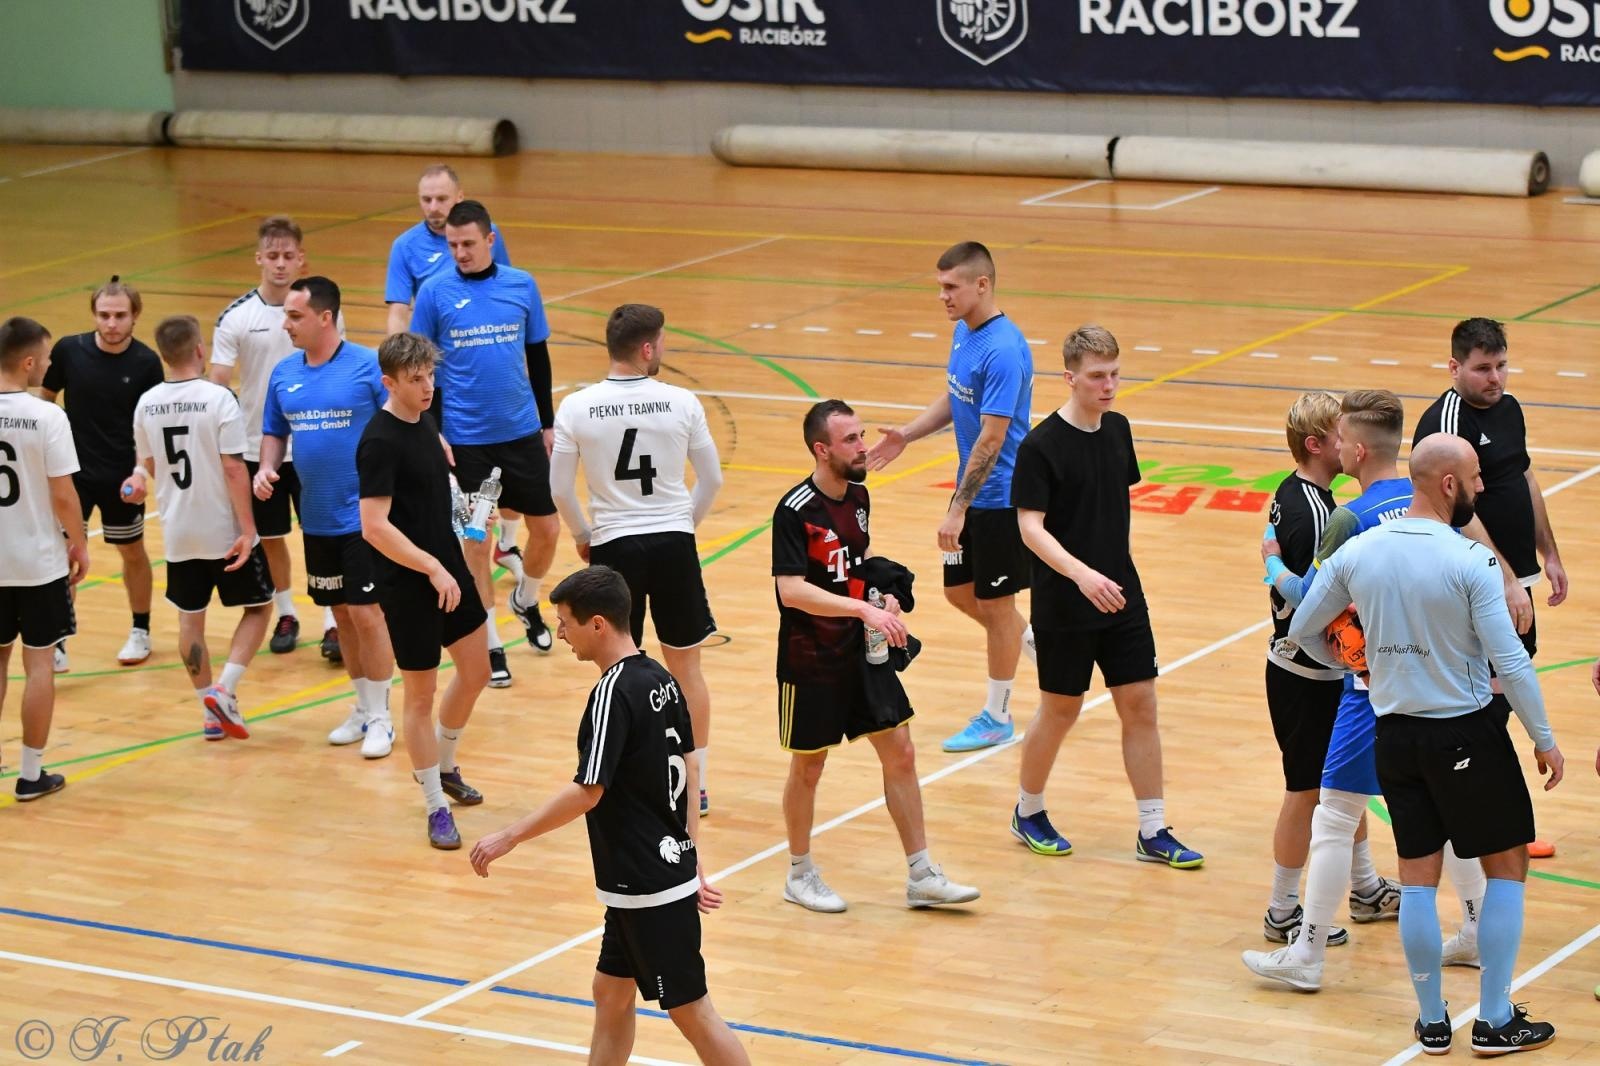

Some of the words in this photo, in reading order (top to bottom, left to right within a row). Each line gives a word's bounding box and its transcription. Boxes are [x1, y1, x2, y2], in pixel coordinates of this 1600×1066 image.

[739, 25, 827, 46] RACIBÓRZ
[589, 404, 624, 420] PIĘKNY
[628, 401, 672, 416] TRAWNIK
[162, 425, 192, 491] 5
[614, 428, 657, 496] 4
